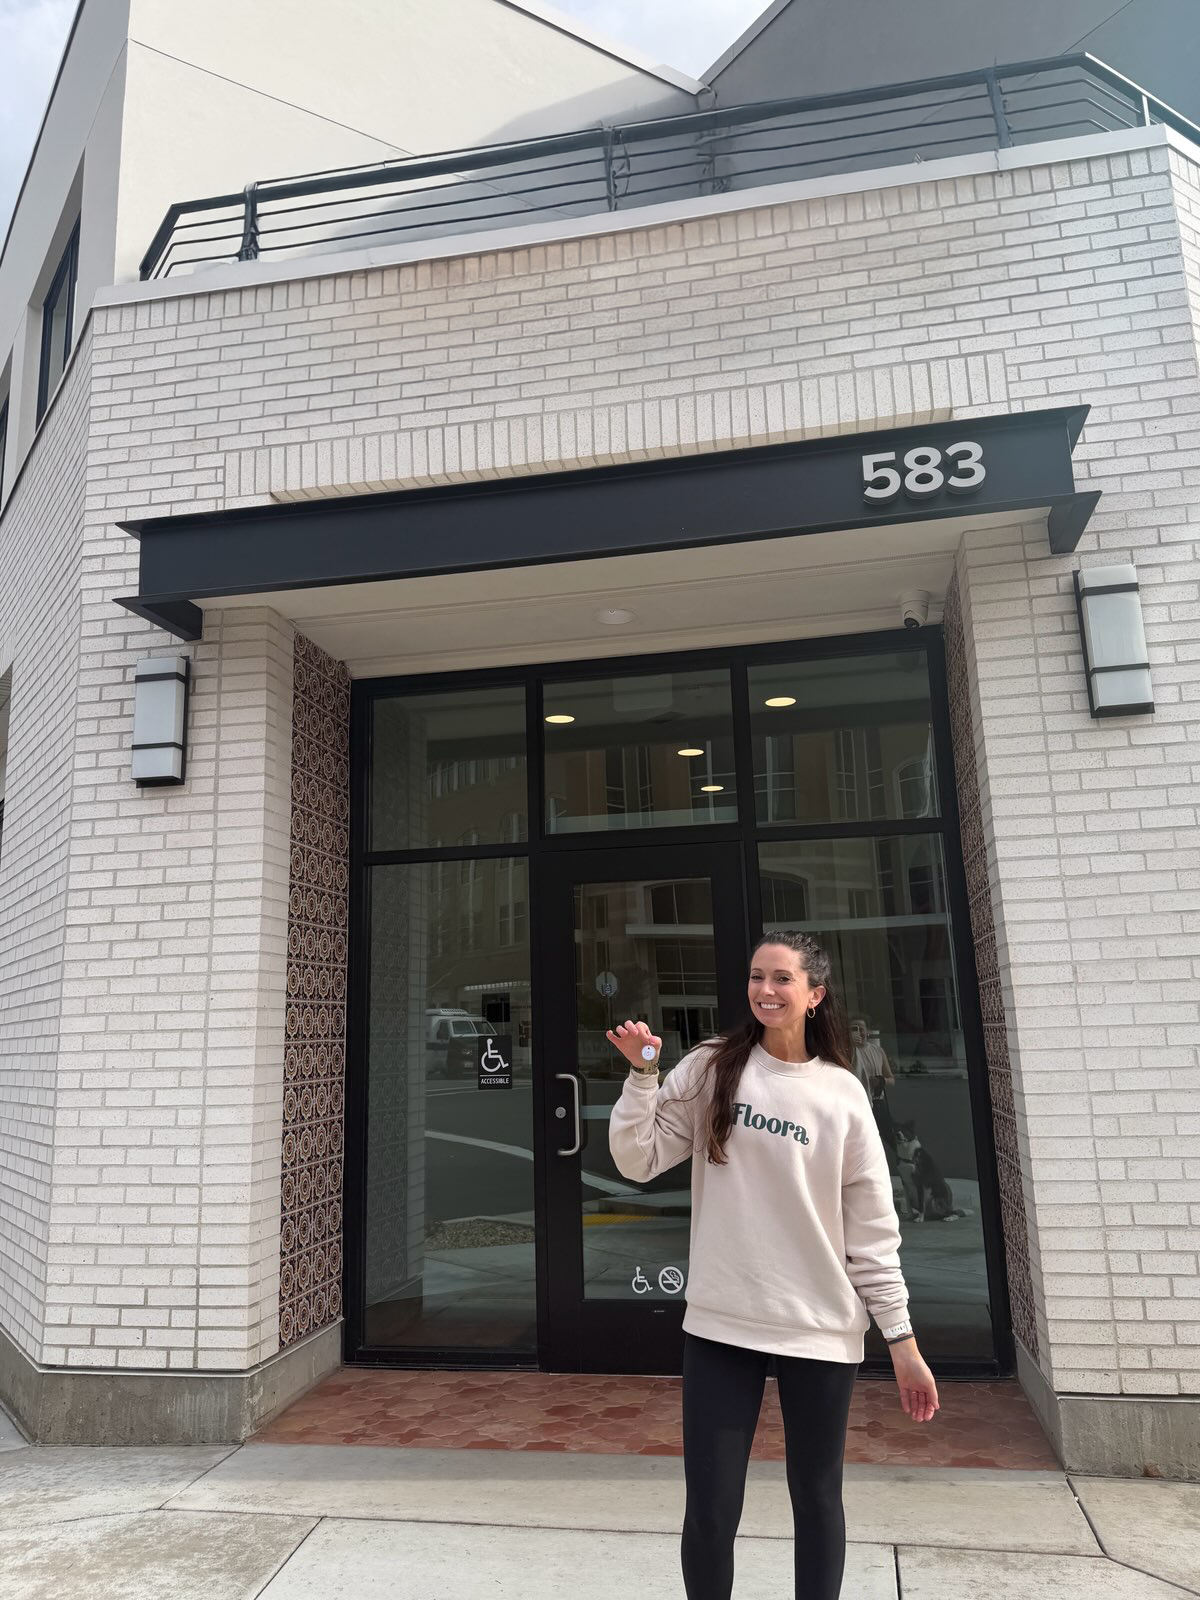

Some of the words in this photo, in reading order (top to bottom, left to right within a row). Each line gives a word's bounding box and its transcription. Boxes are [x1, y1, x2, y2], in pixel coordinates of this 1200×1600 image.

[862, 441, 986, 500] 583
[480, 1077, 510, 1085] ACCESSIBLE
[732, 1102, 810, 1146] Floora
